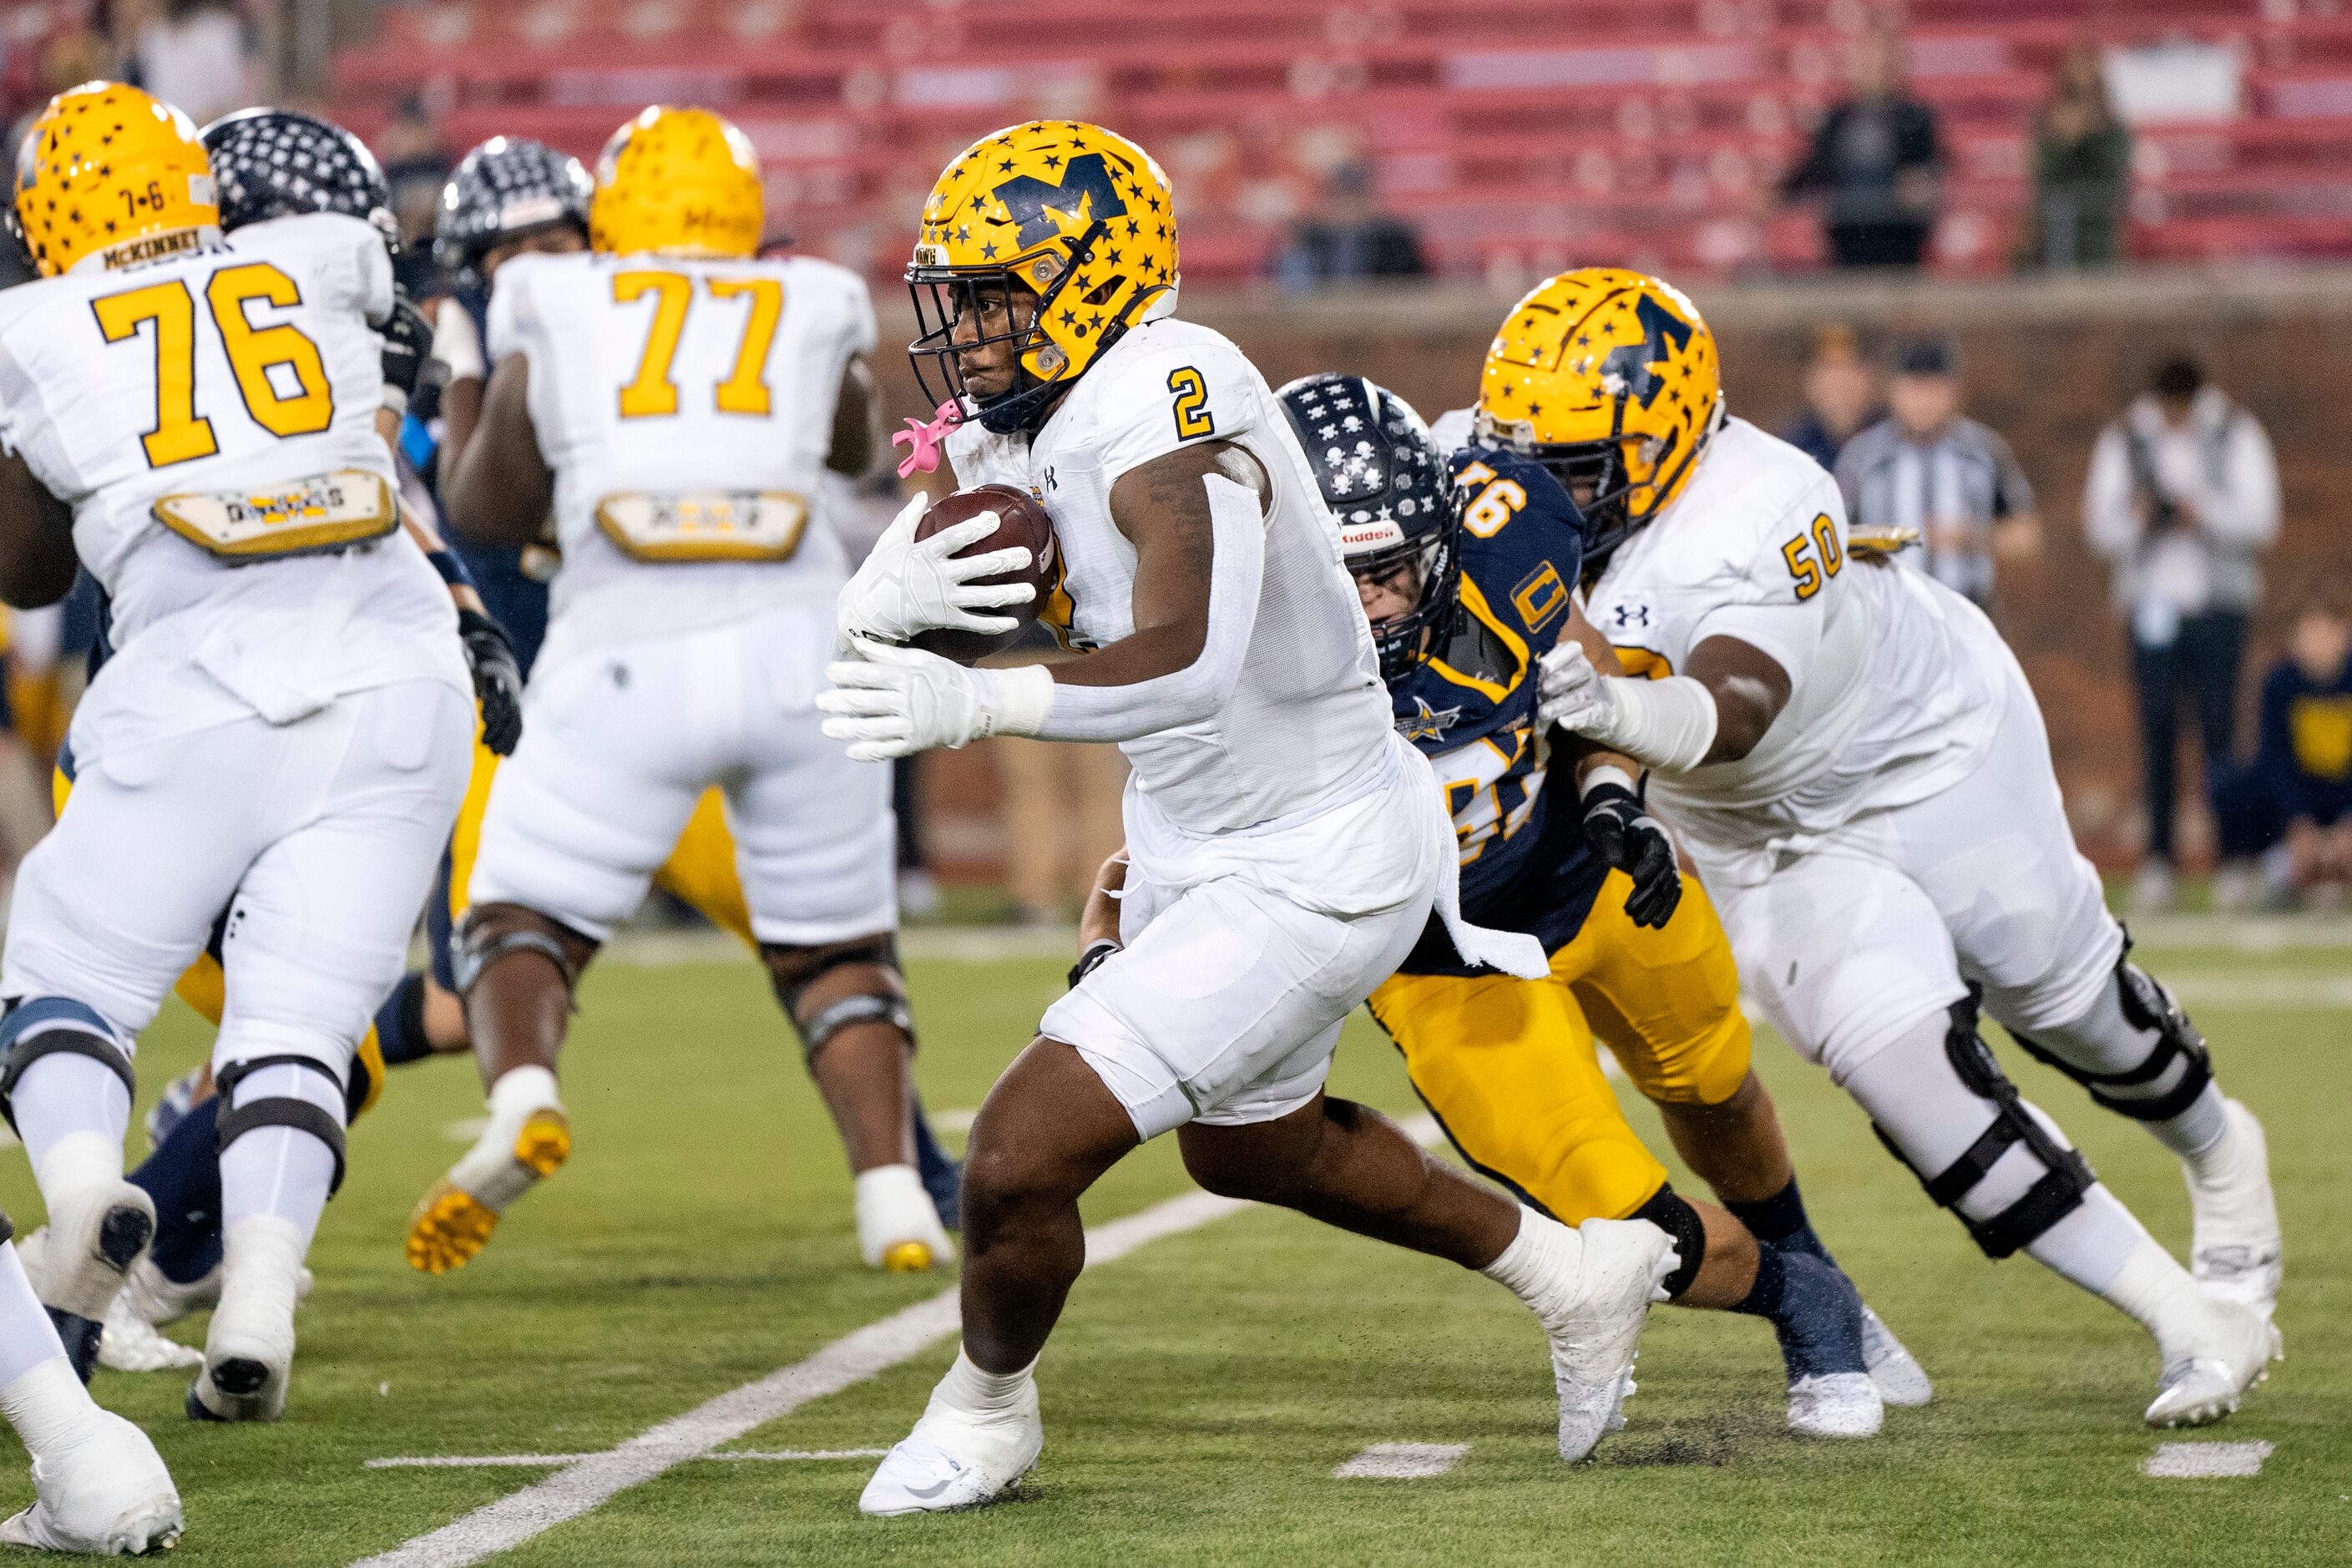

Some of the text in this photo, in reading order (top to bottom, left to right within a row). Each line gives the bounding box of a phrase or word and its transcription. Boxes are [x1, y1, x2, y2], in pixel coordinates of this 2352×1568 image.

[89, 262, 334, 468] 76
[612, 270, 785, 419] 77
[1166, 366, 1215, 442] 2
[1781, 513, 1843, 602] 50
